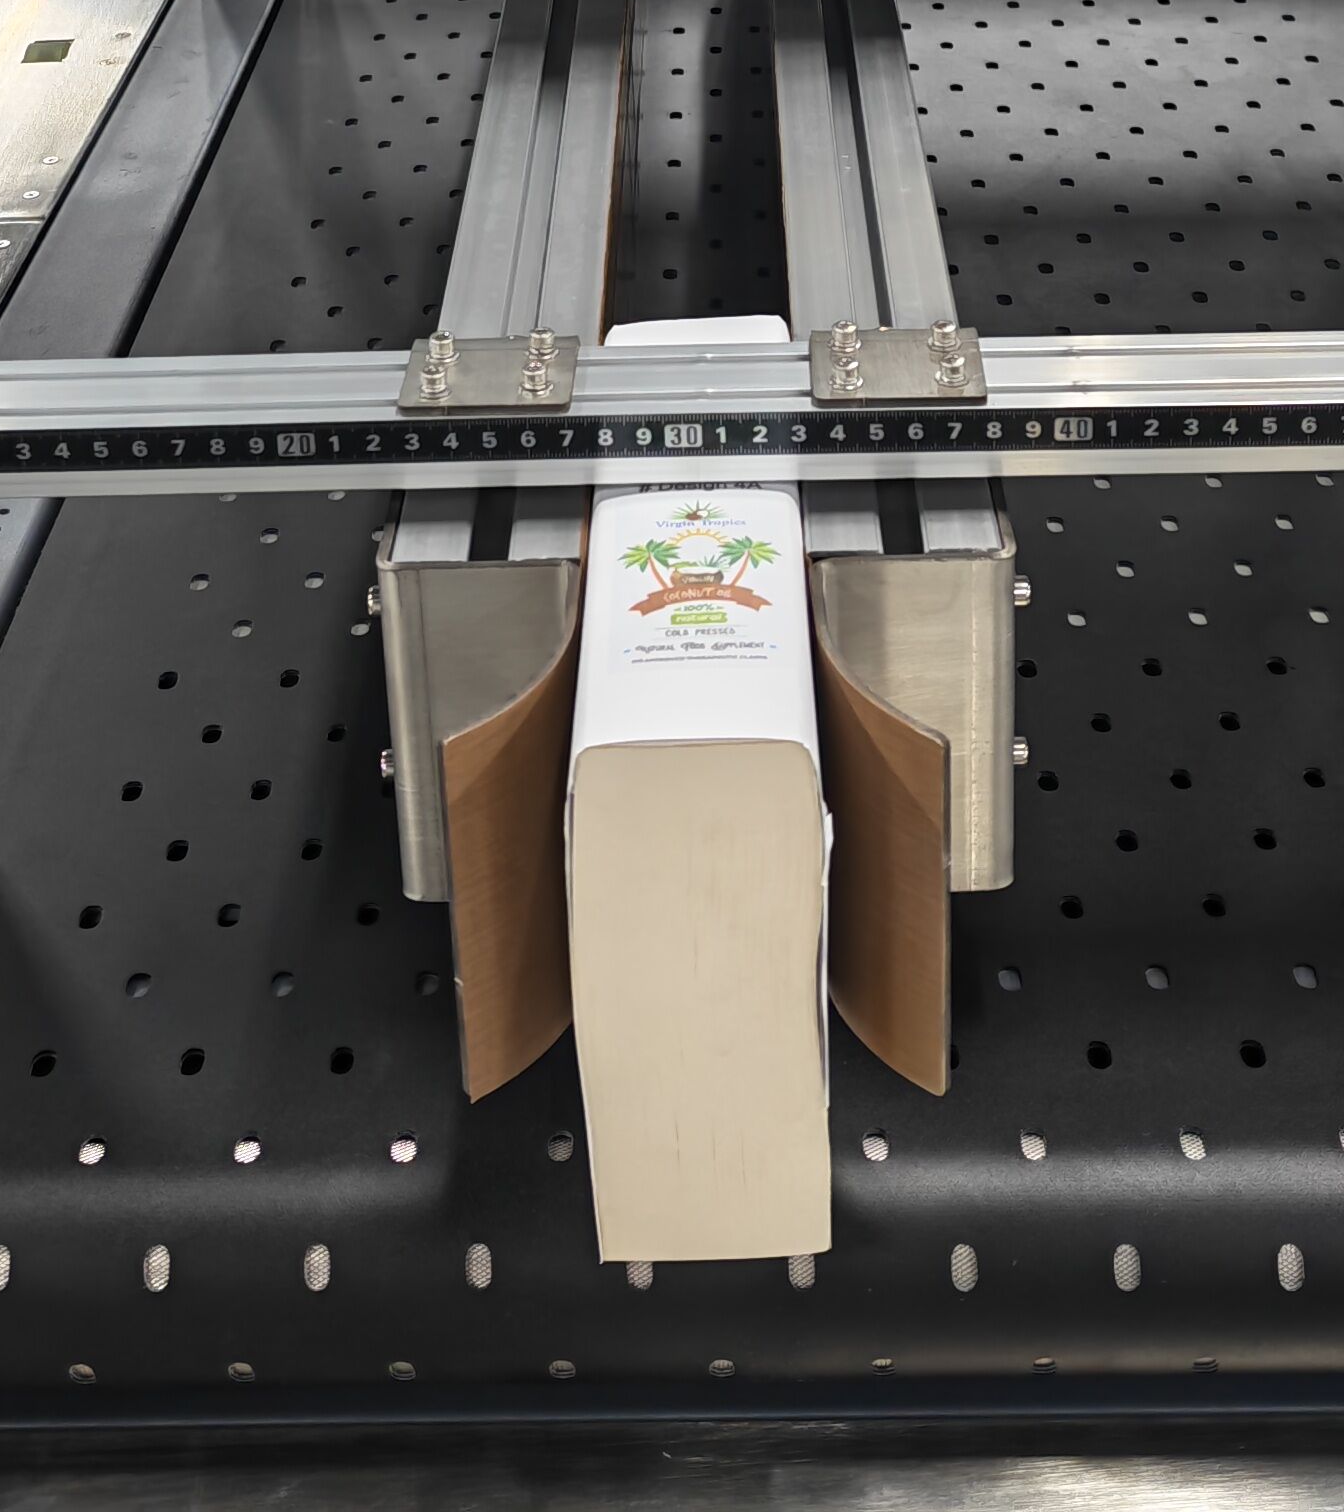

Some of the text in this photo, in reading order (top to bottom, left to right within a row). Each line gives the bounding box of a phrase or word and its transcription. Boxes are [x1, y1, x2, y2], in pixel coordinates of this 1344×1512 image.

[15, 442, 32, 460] 3
[54, 442, 71, 459] 4
[93, 441, 109, 458] 5
[131, 440, 148, 458] 6
[170, 439, 186, 457] 7
[209, 438, 226, 456] 8
[248, 437, 265, 455] 9
[282, 435, 311, 454] 20
[328, 435, 340, 453] 1
[366, 434, 382, 452] 2
[404, 433, 420, 451] 3
[442, 432, 460, 450] 4
[482, 431, 498, 449] 5
[520, 430, 537, 448] 6
[559, 429, 574, 447] 7
[597, 428, 614, 447] 8
[635, 427, 652, 446] 9
[669, 426, 699, 446] 30
[715, 426, 727, 444] 1
[752, 424, 769, 443] 2
[790, 424, 807, 443] 3
[829, 424, 847, 442] 4
[869, 423, 885, 441] 5
[907, 422, 924, 440] 6
[947, 422, 963, 440] 7
[986, 421, 1002, 439] 8
[1025, 420, 1042, 439] 9
[1059, 419, 1088, 439] 40
[1106, 419, 1117, 437] 1
[1143, 418, 1160, 437] 2
[1183, 418, 1200, 436] 3
[1222, 417, 1239, 435] 4
[1262, 416, 1278, 435] 5
[1300, 416, 1318, 434] 6
